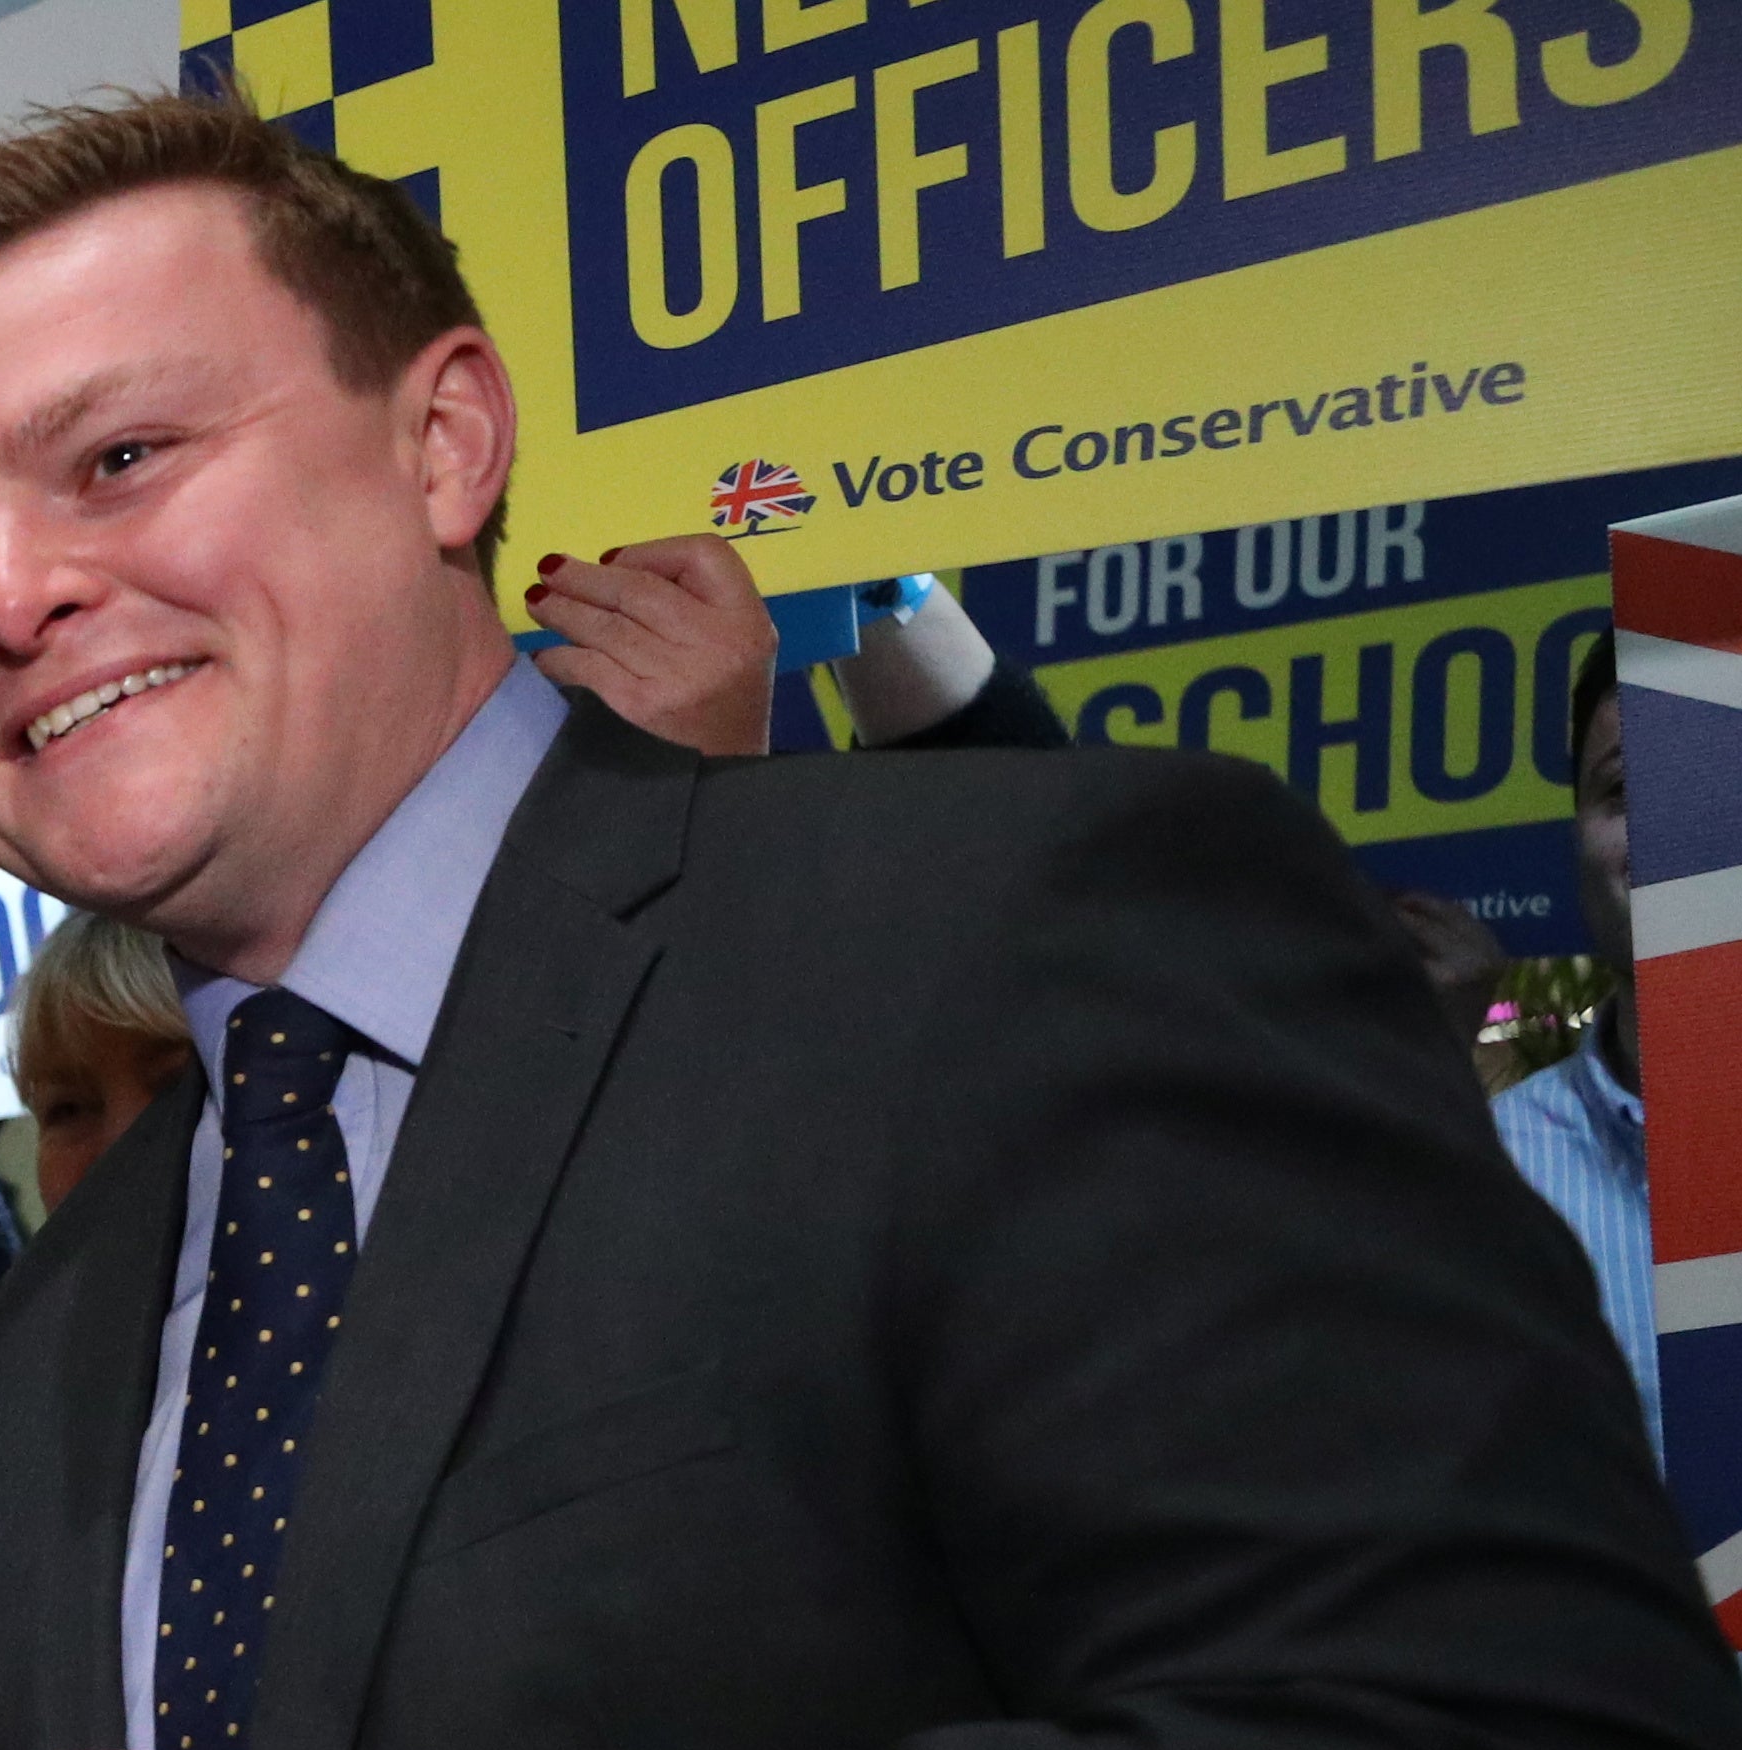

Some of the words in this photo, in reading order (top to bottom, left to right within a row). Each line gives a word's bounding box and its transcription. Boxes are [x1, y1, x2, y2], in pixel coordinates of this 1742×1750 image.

[832, 449, 985, 511] Vote
[1012, 360, 1527, 482] Conservative
[1035, 535, 1203, 646] FOR
[1234, 503, 1425, 611] OUR
